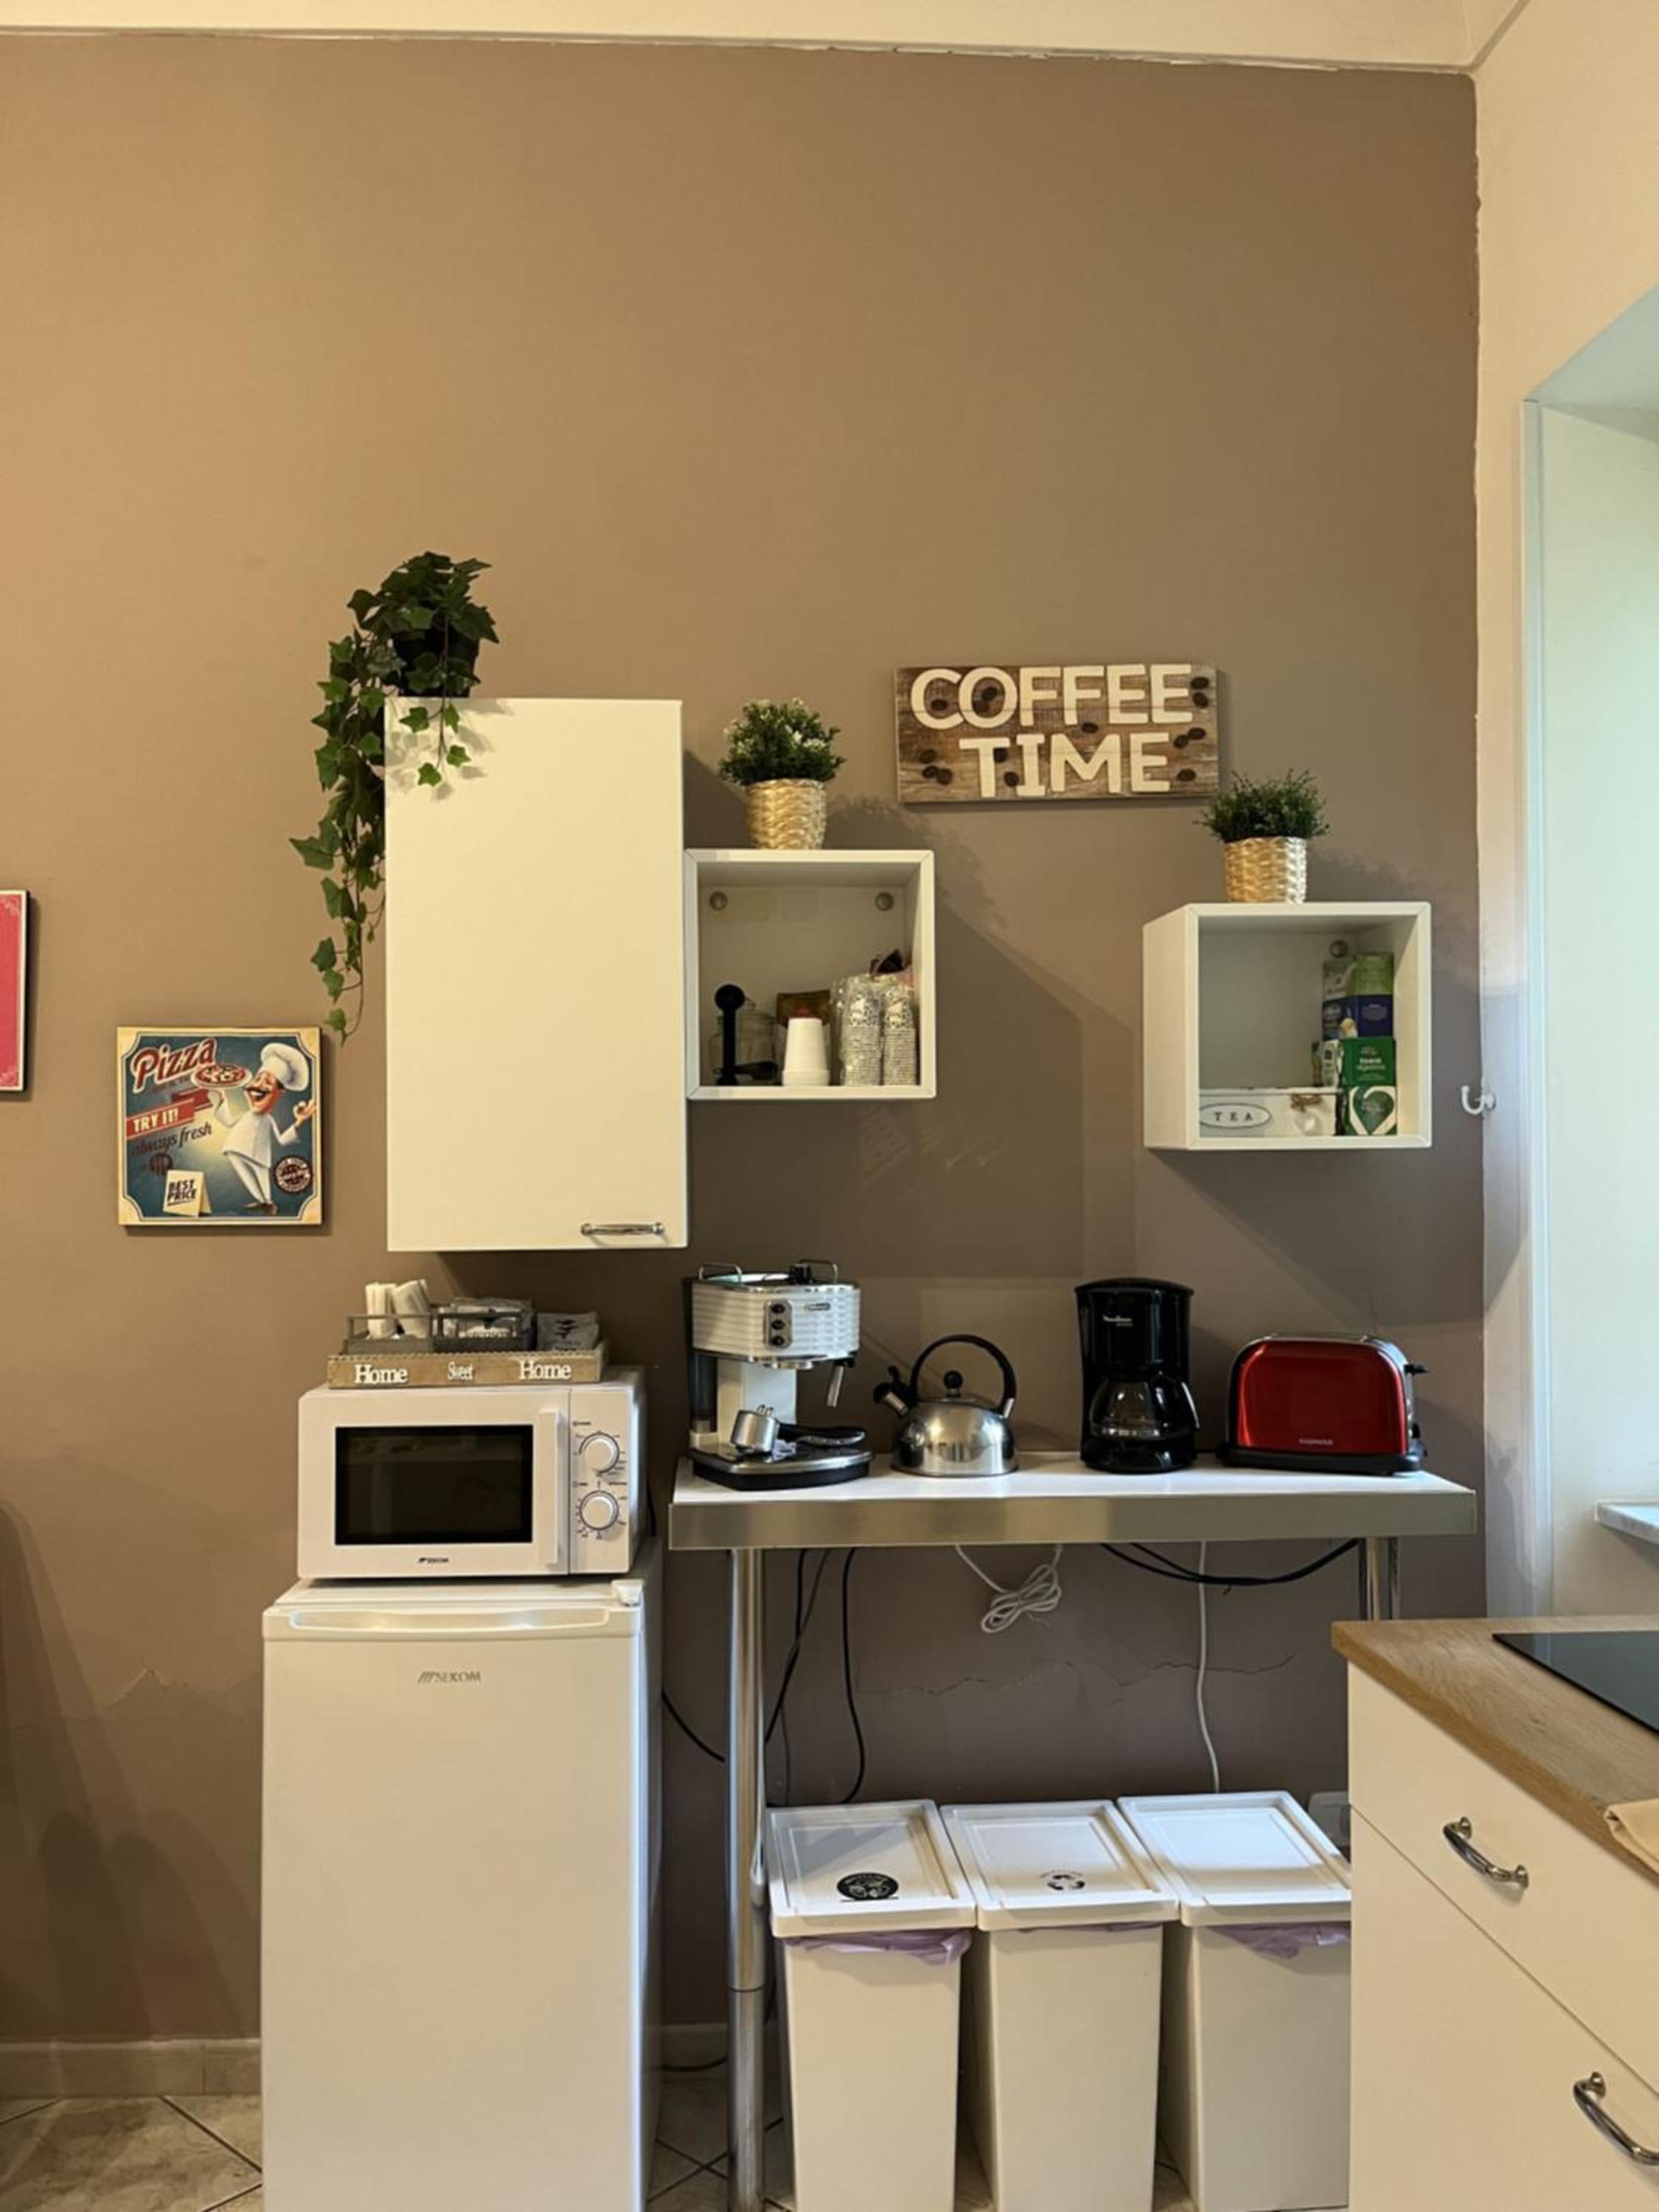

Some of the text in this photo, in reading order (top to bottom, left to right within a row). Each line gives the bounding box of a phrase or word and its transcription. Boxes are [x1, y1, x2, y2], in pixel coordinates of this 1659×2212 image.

[911, 664, 1193, 730] COFFEE
[959, 732, 1170, 799] TIME
[131, 1038, 217, 1093] Pizza
[133, 1107, 179, 1133] TRY IT!
[1214, 1111, 1253, 1121] TEA
[178, 1120, 212, 1148] fresh
[167, 1188, 198, 1201] PRICE
[169, 1179, 195, 1193] BEST
[354, 1360, 572, 1384] Home Sweet Home
